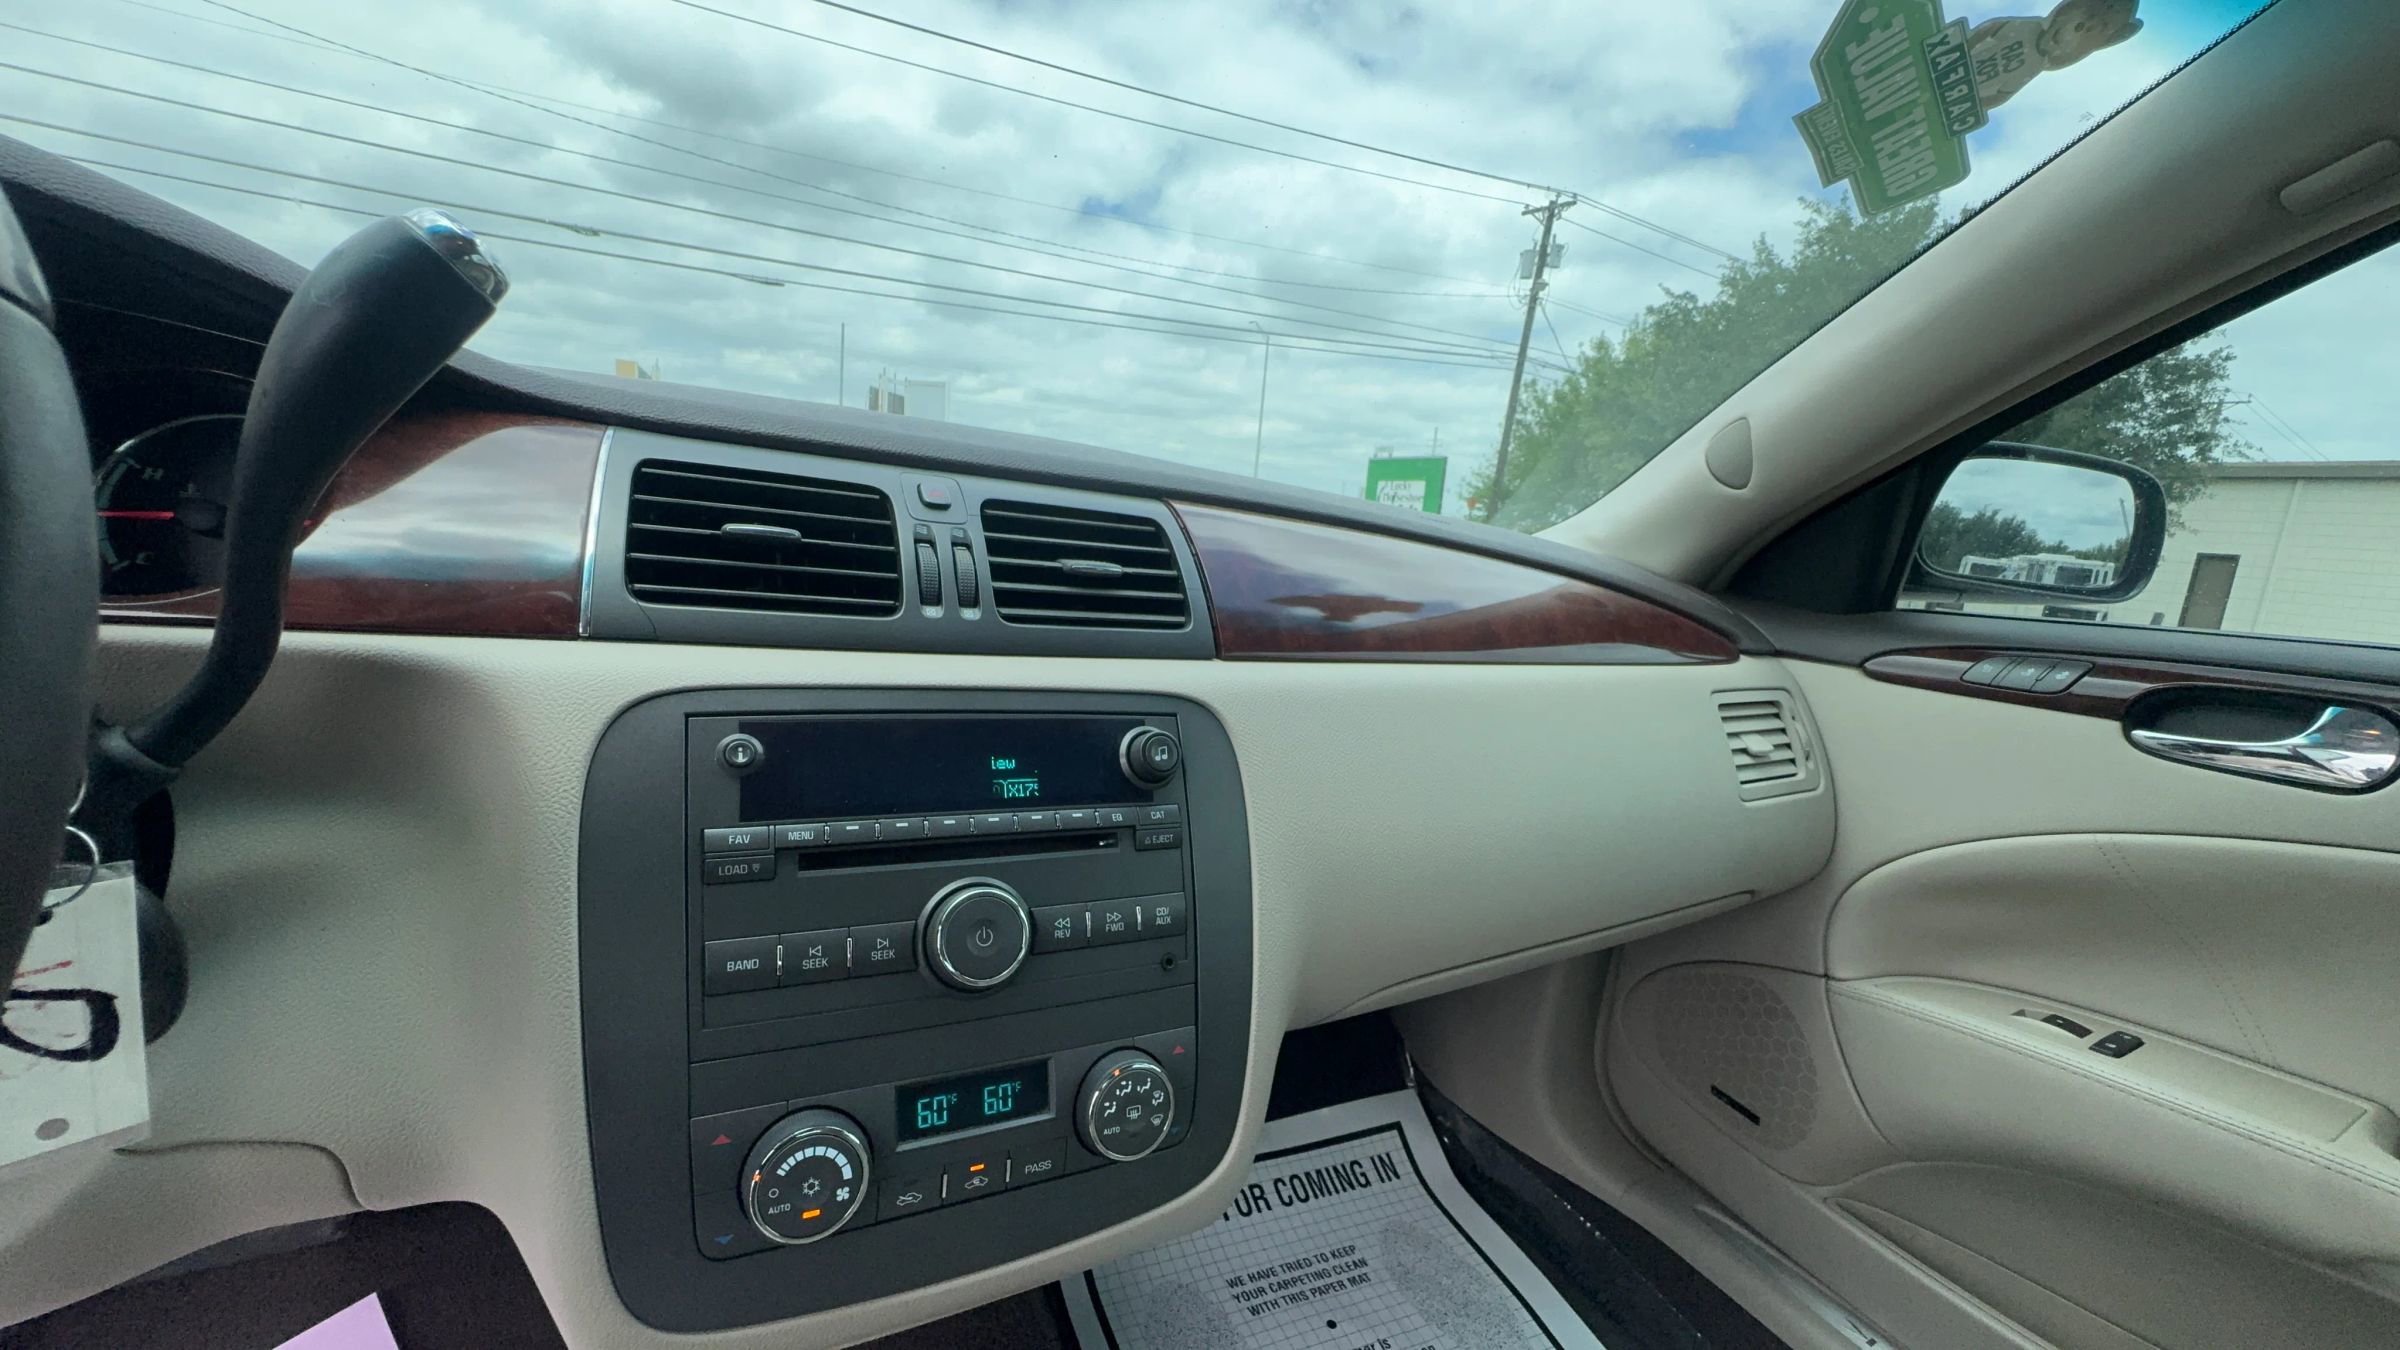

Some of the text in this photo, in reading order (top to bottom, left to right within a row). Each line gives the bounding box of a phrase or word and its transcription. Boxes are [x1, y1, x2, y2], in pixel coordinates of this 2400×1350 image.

[1111, 813, 1123, 822] EQ
[1150, 811, 1165, 820] CAT
[728, 834, 751, 845] FAV
[788, 831, 814, 841] MENU
[1152, 834, 1174, 844] EJECT
[718, 864, 748, 876] LOAD
[1156, 907, 1169, 916] CD/
[1155, 915, 1171, 925] AUX
[1105, 922, 1125, 932] FWD
[1054, 929, 1071, 938] REV
[871, 949, 896, 961] SEEK
[726, 958, 760, 972] BAND
[802, 957, 829, 970] SEEK
[1103, 1126, 1120, 1136] AUTO
[1025, 1160, 1052, 1174] PASS
[1223, 1152, 1401, 1222] OR COMING IN
[768, 1203, 791, 1215] AUTO
[1226, 1244, 1357, 1290] WE HAVE TRIED TO KEEP
[1232, 1257, 1369, 1304] YOUR CARPETING CLEAN
[1246, 1271, 1372, 1317] WITH THIS PAPER MAT
